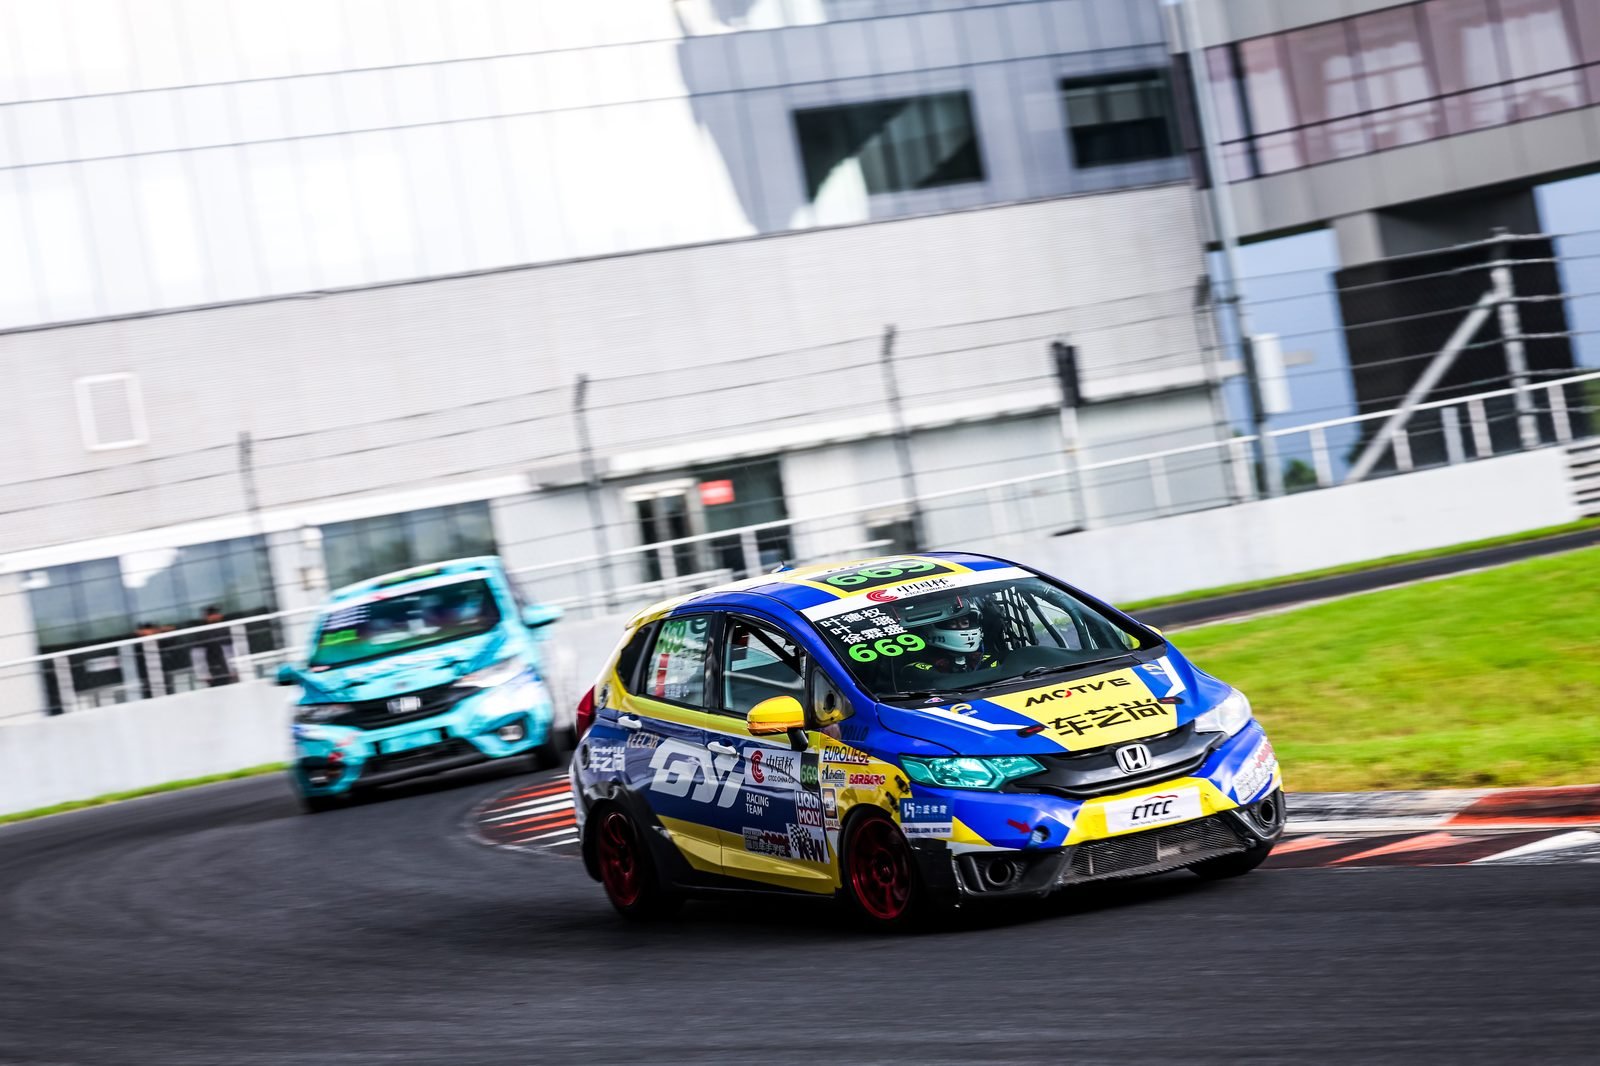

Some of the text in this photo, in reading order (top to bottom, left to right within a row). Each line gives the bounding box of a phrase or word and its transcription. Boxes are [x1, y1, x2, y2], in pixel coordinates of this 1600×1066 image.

[826, 561, 936, 586] 669
[848, 633, 926, 663] 669
[1047, 698, 1169, 736] 车艺尚
[766, 754, 795, 777] 中国杯
[800, 764, 818, 785] 669
[745, 803, 763, 817] TEAM
[746, 792, 770, 808] RACING
[1131, 799, 1174, 821] CTCC
[798, 809, 821, 826] MOLY
